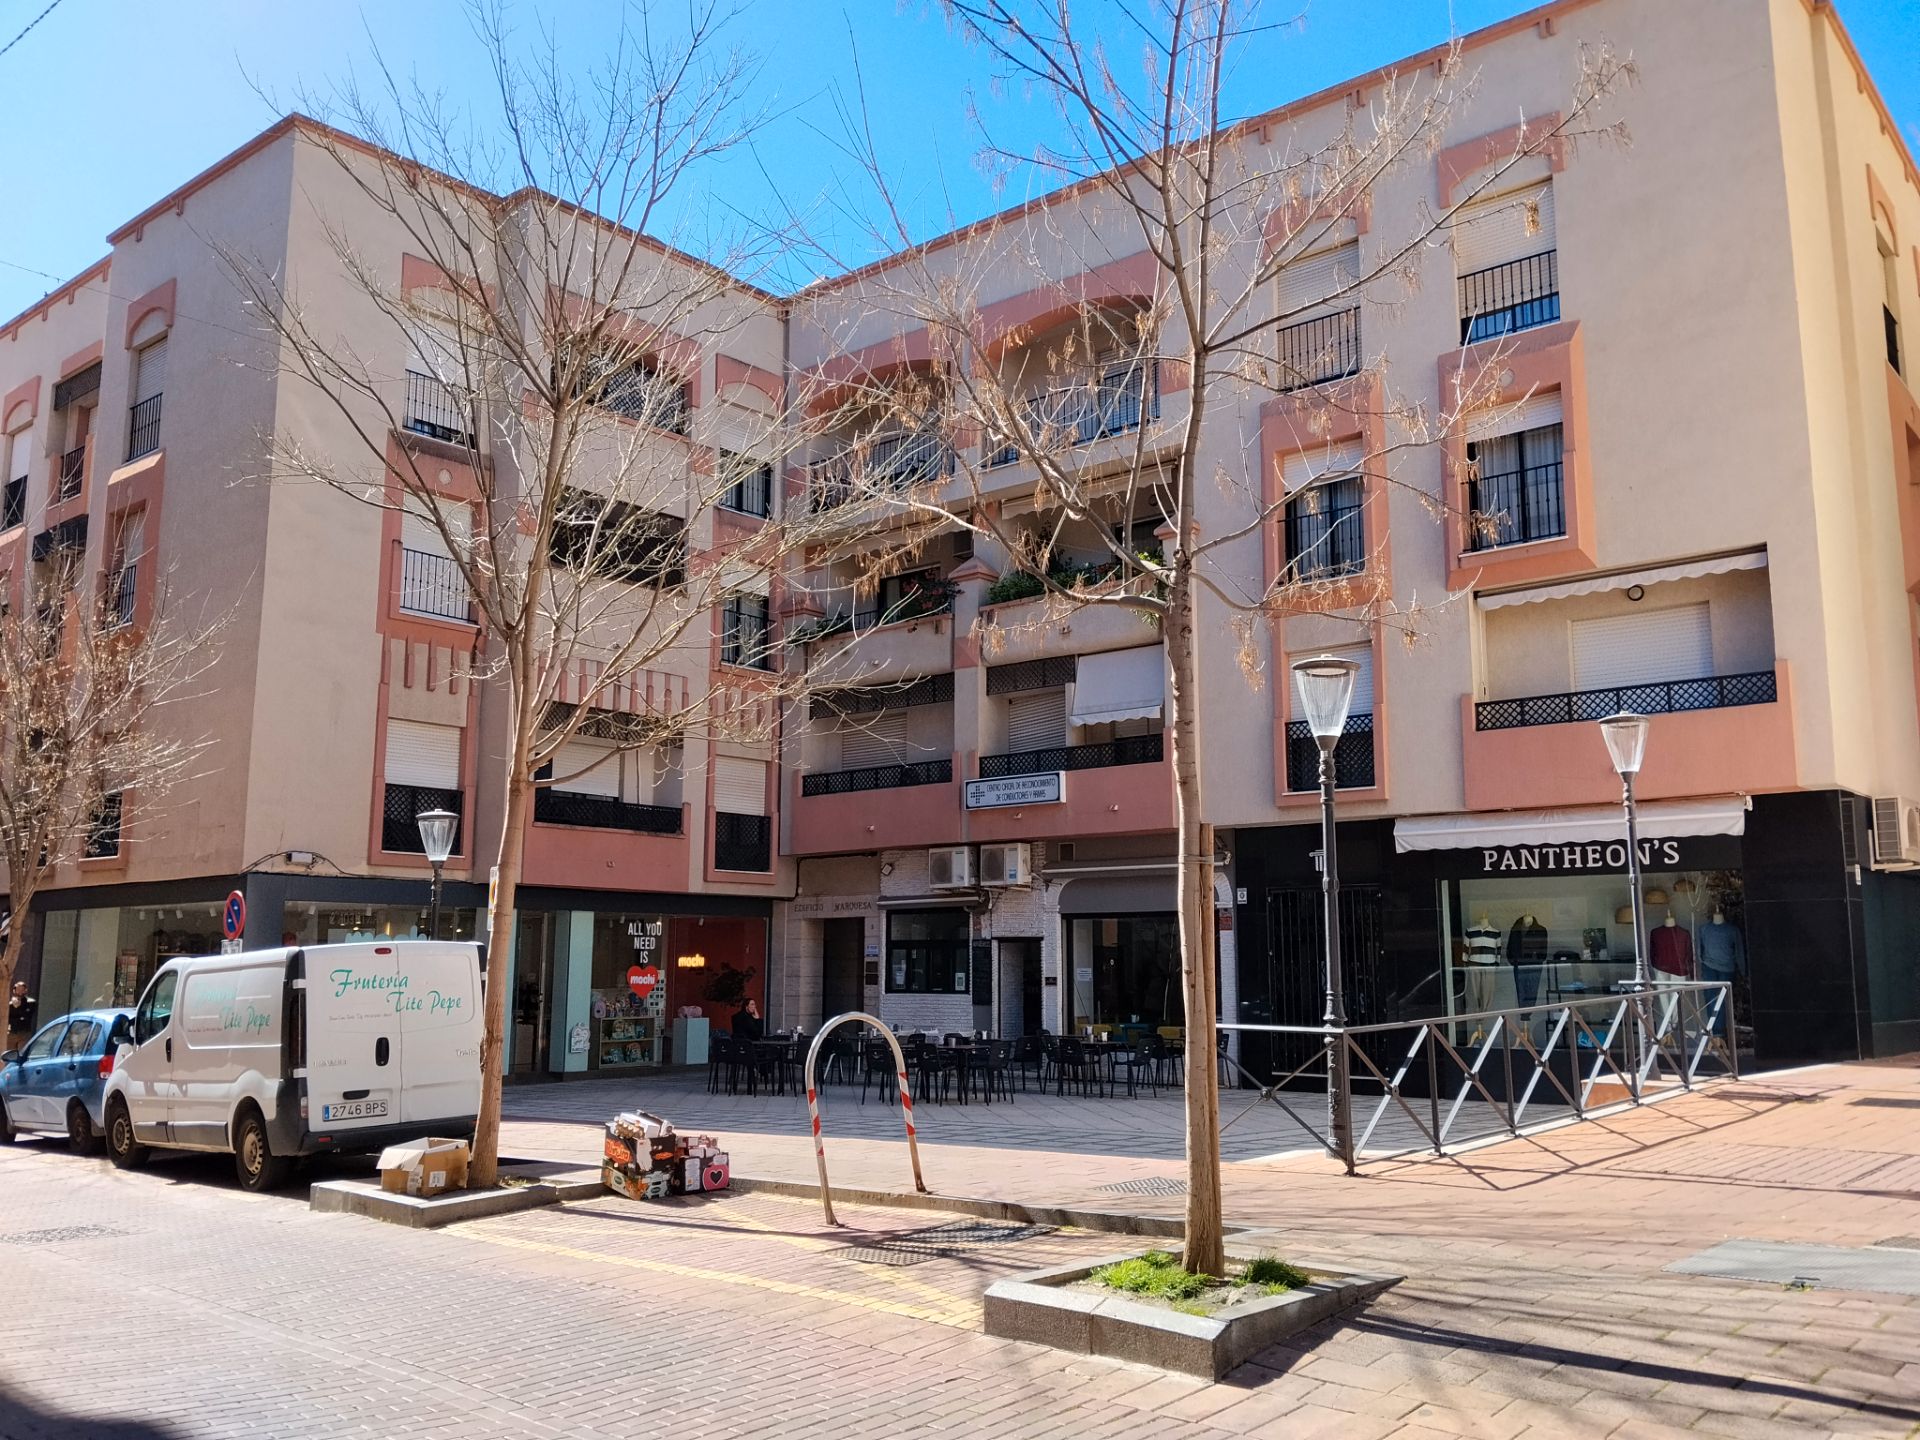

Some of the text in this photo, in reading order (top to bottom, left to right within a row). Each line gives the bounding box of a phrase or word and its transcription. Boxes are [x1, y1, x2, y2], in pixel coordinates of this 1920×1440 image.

[986, 778, 1056, 793] CENTRO OFICIAL DE RECONOCIMIENTO
[996, 793, 1001, 802] DE
[1001, 791, 1028, 801] CONDUCTORES
[1033, 789, 1046, 799] ARMAS
[1483, 839, 1680, 871] PANTHEON'S
[794, 902, 872, 912] EDIFICIO MARQUESA
[628, 922, 662, 936] ALL YOU
[634, 937, 656, 950] NEED
[640, 951, 649, 963] IS
[630, 973, 656, 984] mochi
[386, 990, 462, 1016] Tite Pepe
[332, 1102, 387, 1118] 2746 BPS
